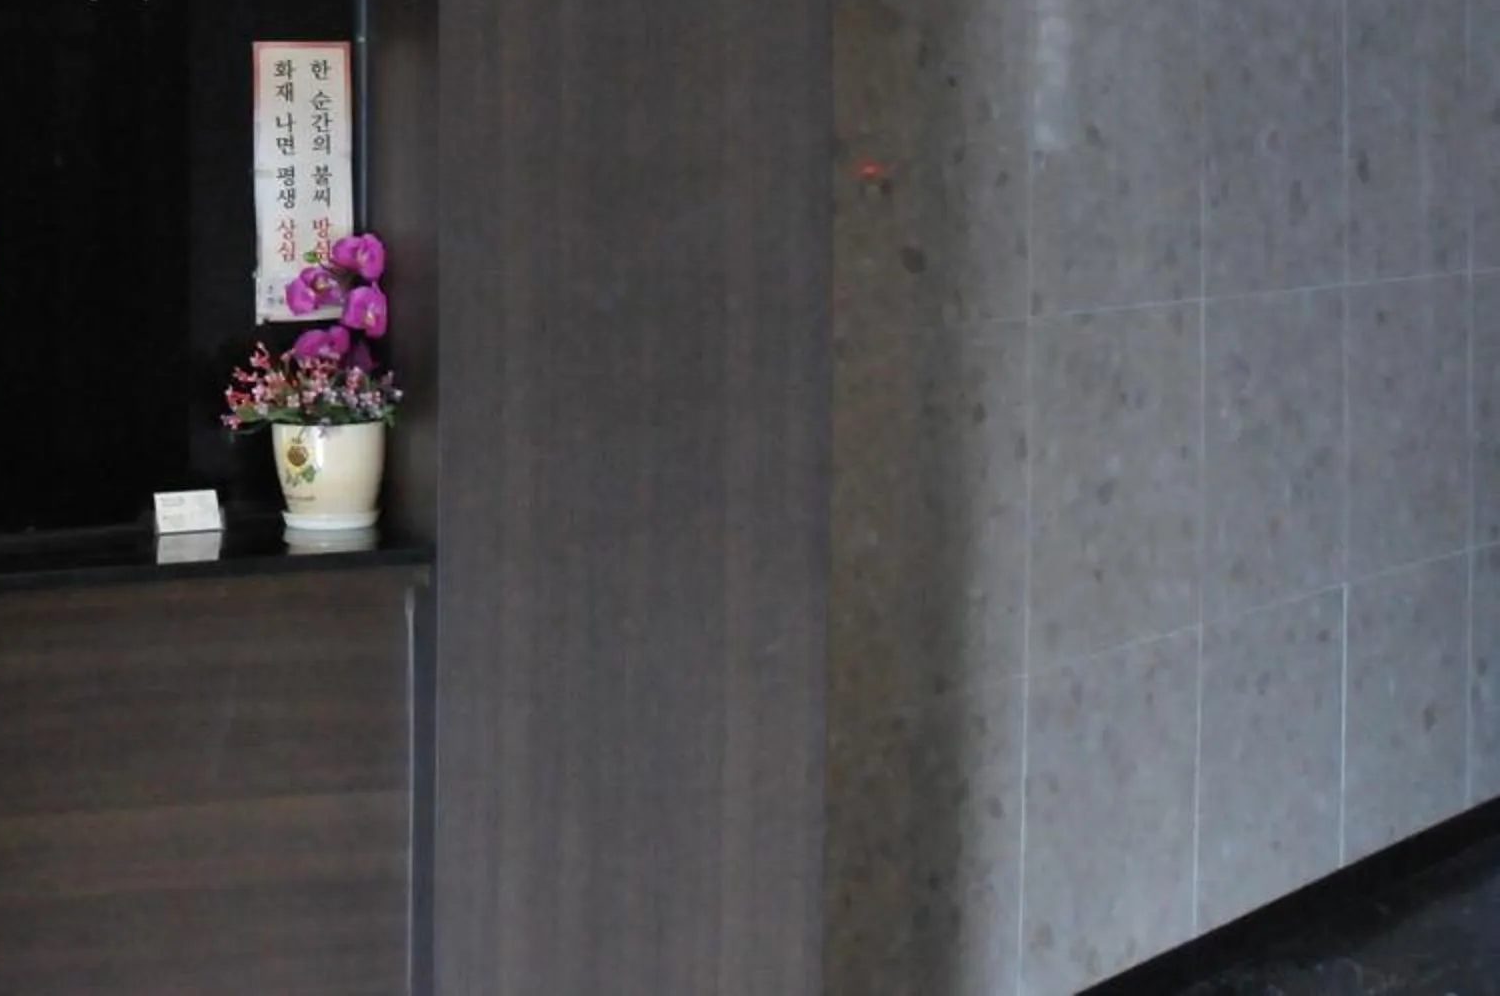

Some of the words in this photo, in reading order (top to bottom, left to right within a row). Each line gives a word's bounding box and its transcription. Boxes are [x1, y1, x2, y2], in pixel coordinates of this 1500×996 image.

[274, 59, 296, 103] 화재
[310, 59, 332, 80] 한
[275, 112, 296, 156] 나면
[310, 91, 333, 155] 순간의
[275, 165, 296, 209] 평생
[311, 165, 333, 208] 불씨
[275, 219, 296, 262] 상심
